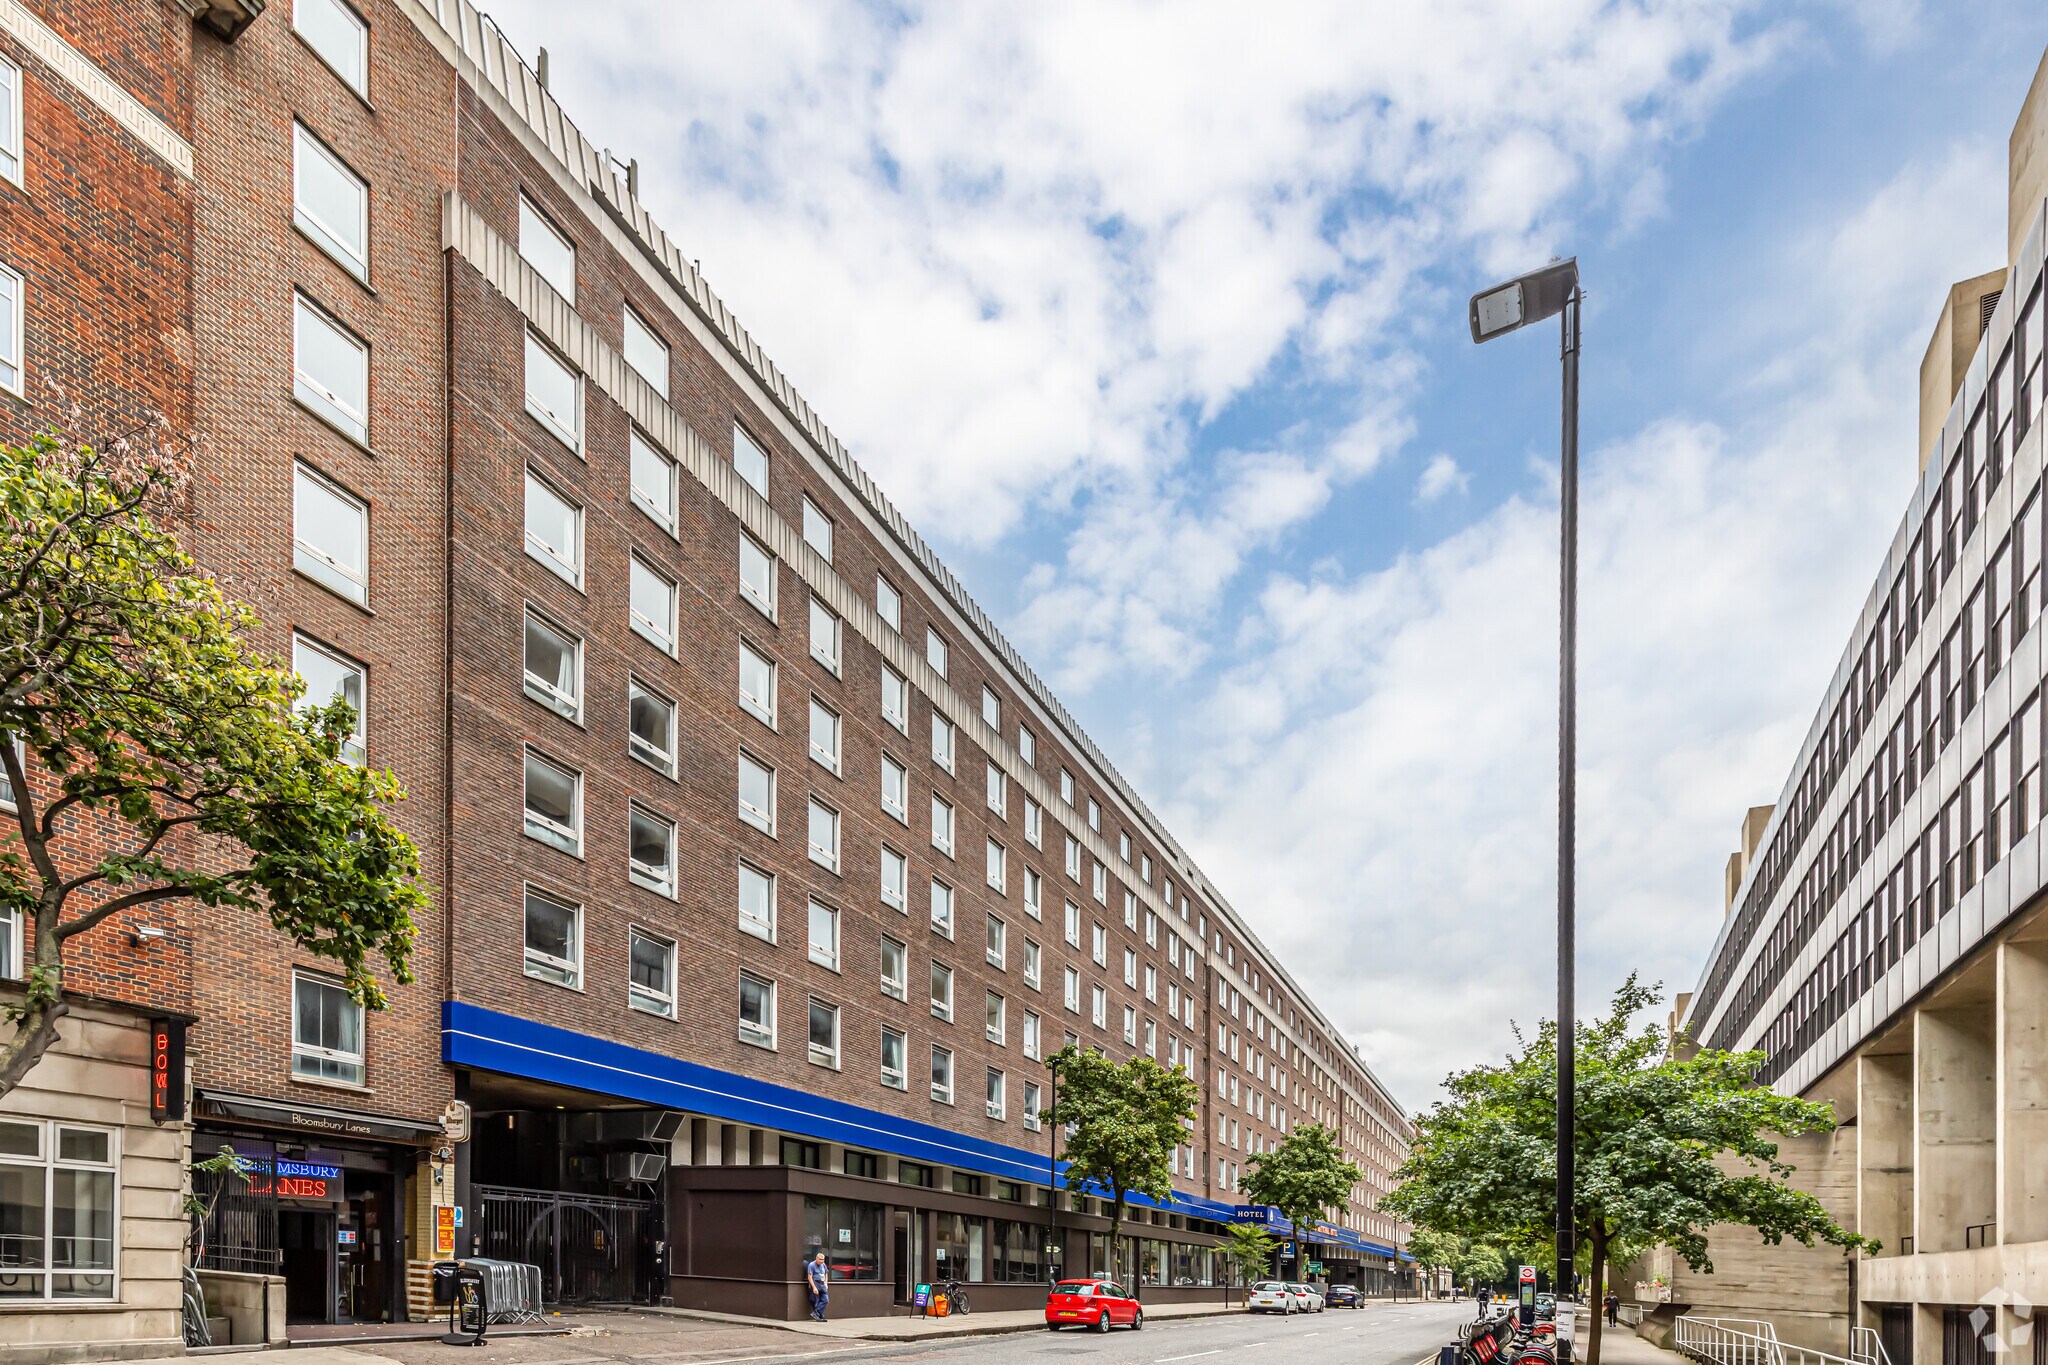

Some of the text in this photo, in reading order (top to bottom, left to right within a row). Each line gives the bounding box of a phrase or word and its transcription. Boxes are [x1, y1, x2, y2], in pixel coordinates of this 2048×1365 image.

[156, 1033, 168, 1108] BOWL
[292, 1113, 371, 1134] Bloomsbury Lanes
[1283, 1242, 1291, 1252] P
